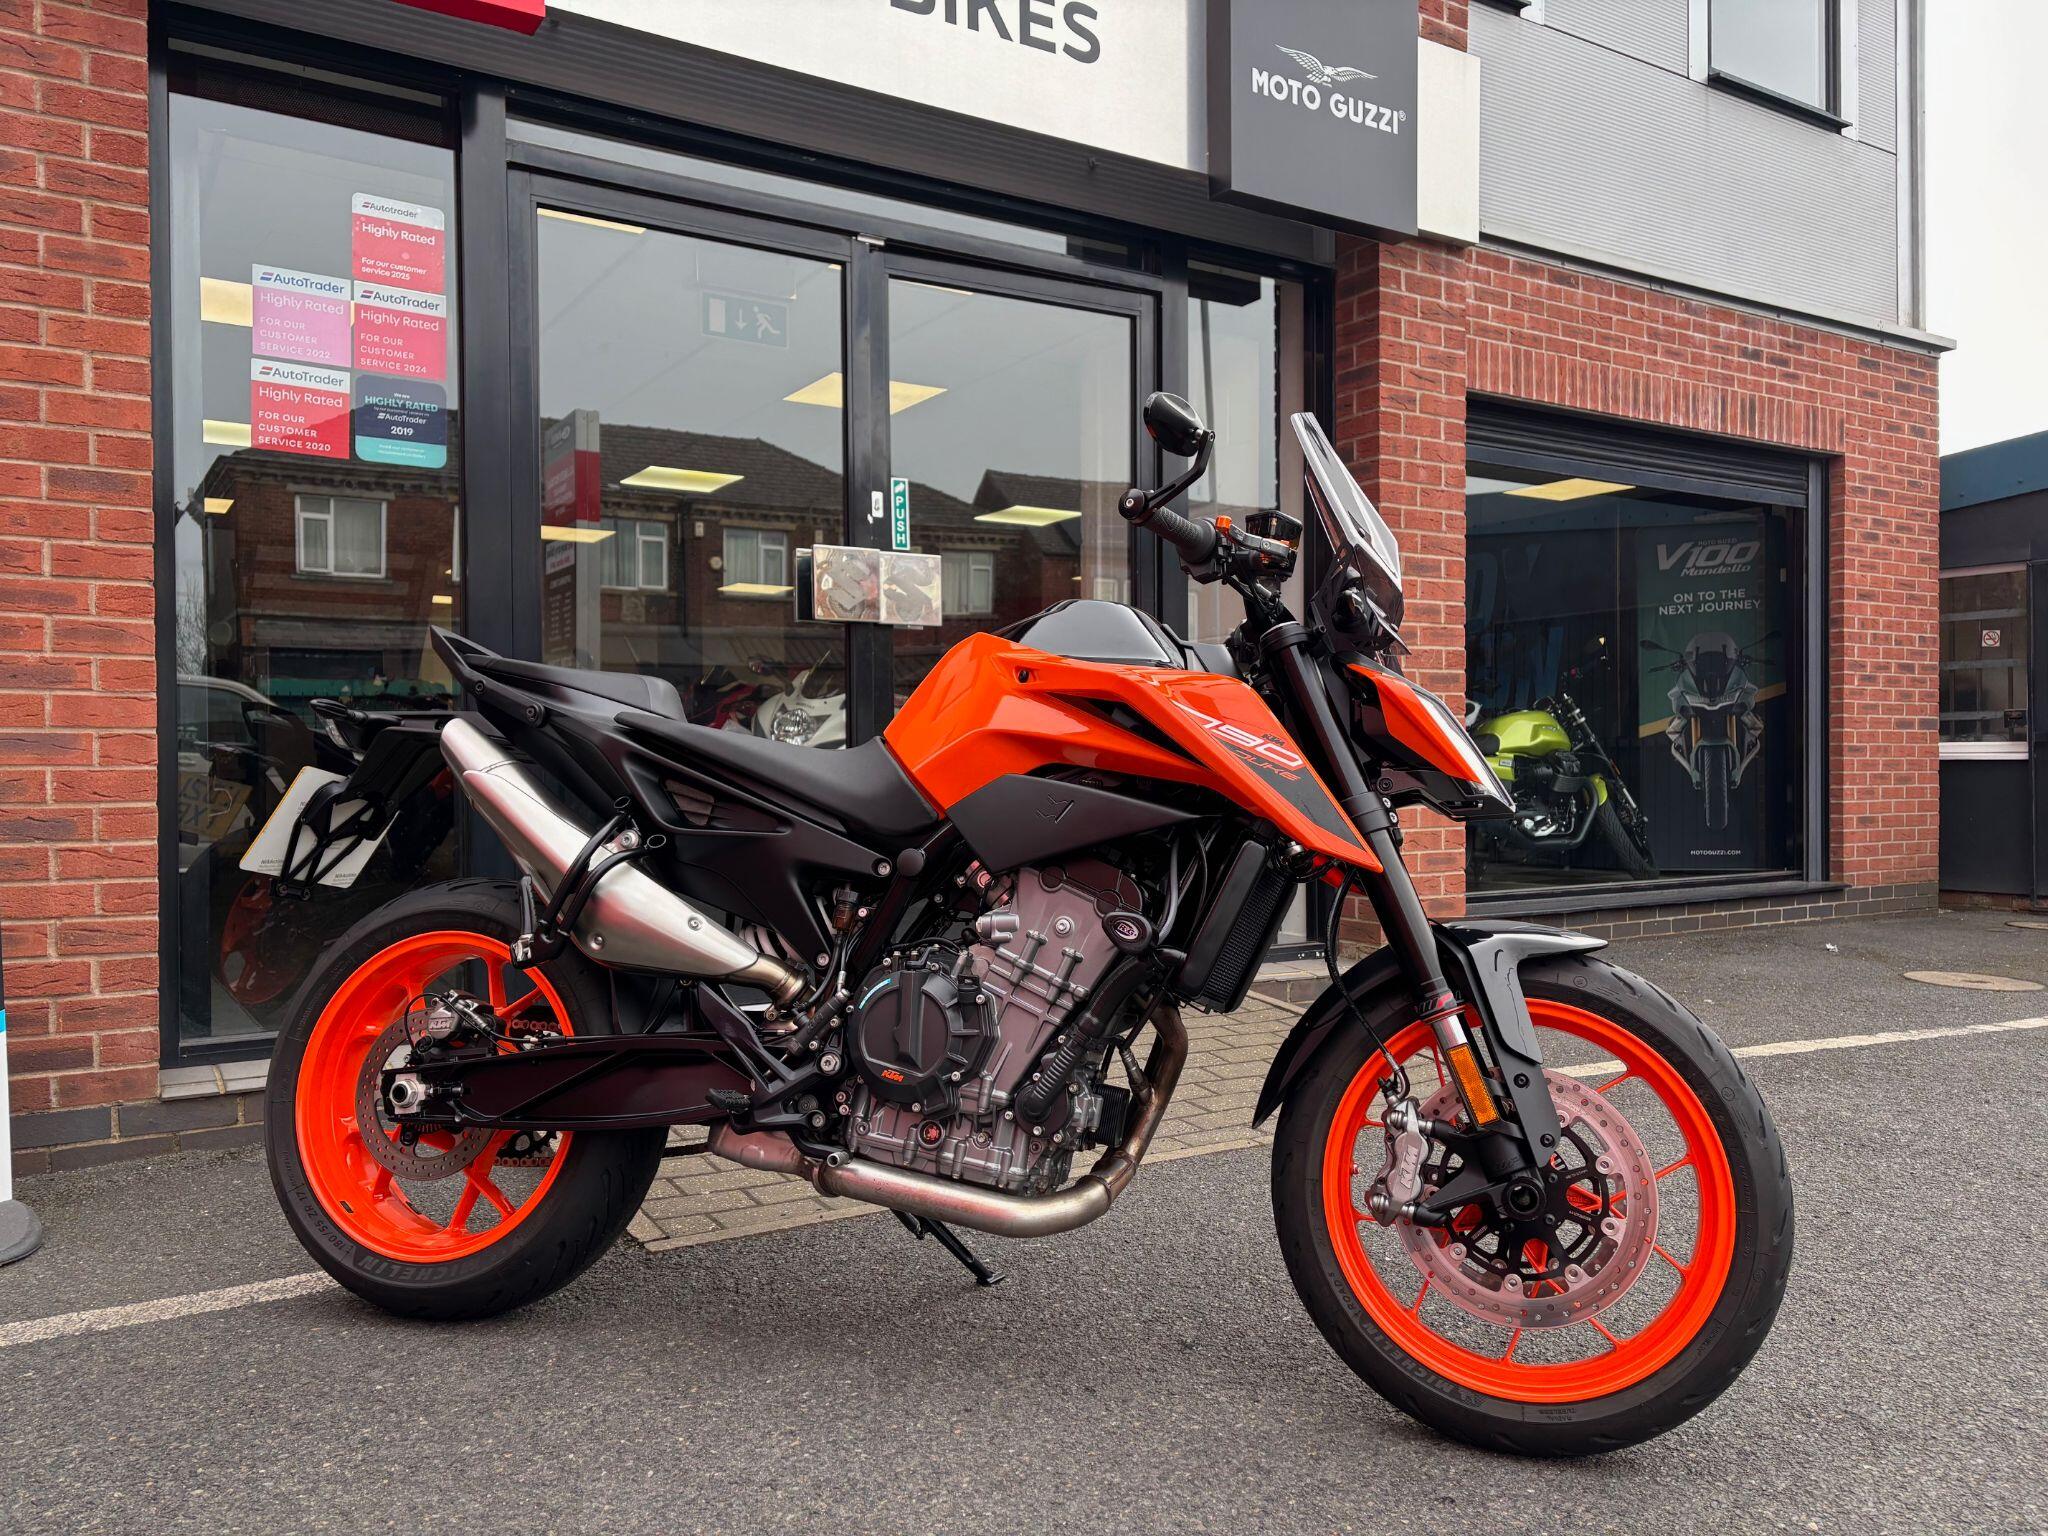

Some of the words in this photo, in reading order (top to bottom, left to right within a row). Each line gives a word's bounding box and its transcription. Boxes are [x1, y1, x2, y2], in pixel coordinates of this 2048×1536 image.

[890, 0, 1101, 64] KES
[1252, 67, 1321, 111] MOTO
[369, 202, 418, 219] Autotrader
[362, 222, 399, 241] Highly
[400, 230, 436, 246] Rated
[361, 256, 375, 266] For
[375, 261, 389, 269] our
[389, 264, 427, 276] customer
[361, 266, 391, 278] service
[390, 271, 411, 281] 2025
[273, 273, 345, 294] AutoTrader
[260, 292, 303, 311] Highly
[304, 300, 344, 315] Rated
[373, 291, 440, 311] AutoTrader
[260, 316, 281, 327] FOR
[283, 320, 305, 330] OUR
[360, 309, 400, 327] Highly
[402, 316, 439, 331] Rated
[260, 329, 317, 345] CUSTOMER
[360, 332, 380, 343] FOR
[382, 336, 404, 346] OUR
[260, 341, 304, 355] SERVICE
[305, 348, 330, 359] 2022
[360, 345, 415, 360] CUSTOMER
[360, 357, 401, 371] SERVICE
[403, 364, 427, 374] 2024
[272, 368, 344, 387] AutoTrader
[259, 386, 301, 404] Highly
[304, 393, 343, 408] Rated
[364, 395, 404, 408] HIGHLY
[405, 401, 439, 413] RATED
[258, 410, 280, 421] FOR
[282, 414, 305, 424] OUR
[384, 413, 427, 425] AutoTrader
[258, 423, 317, 438] CUSTOMER
[390, 425, 414, 436] 2019
[258, 435, 303, 449] SERVICE
[305, 441, 331, 452] 2020
[895, 495, 906, 545] PUSH
[1657, 541, 1760, 571] V100
[1680, 562, 1752, 577] Mandello
[1673, 593, 1693, 603] ON
[1697, 590, 1716, 601] TO
[1720, 588, 1746, 599] THE
[1659, 604, 1694, 616] NEXT
[1697, 599, 1761, 613] JOURNEY
[1170, 699, 1304, 768] 790
[1232, 749, 1302, 781] DUKE
[881, 1069, 905, 1082] KTM
[1400, 1144, 1419, 1190] KTM
[1363, 1322, 1455, 1393] MICHELIN
